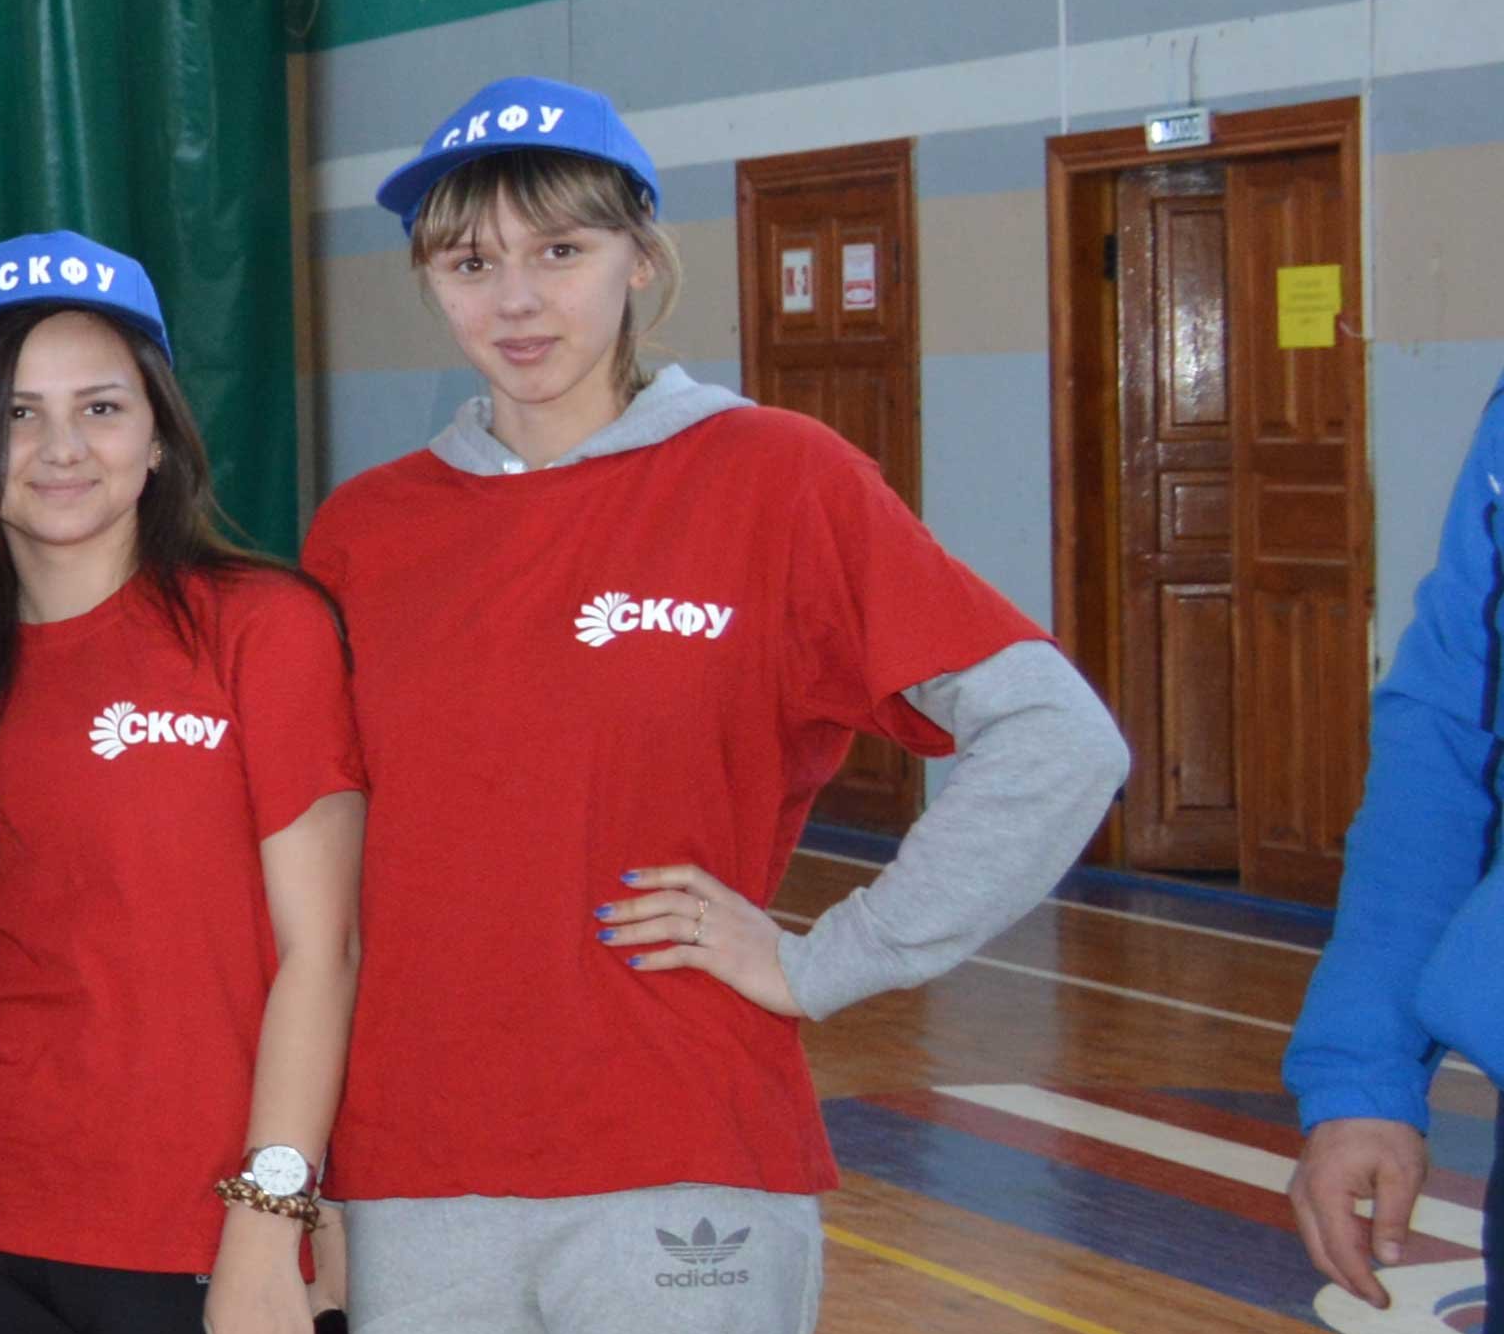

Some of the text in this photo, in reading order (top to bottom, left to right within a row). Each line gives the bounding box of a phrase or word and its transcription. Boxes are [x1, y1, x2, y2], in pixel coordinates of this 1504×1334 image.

[442, 104, 564, 148] СКФУ
[611, 595, 733, 640] СКФУ
[120, 709, 229, 751] СКФУ
[655, 1269, 750, 1288] adidas
